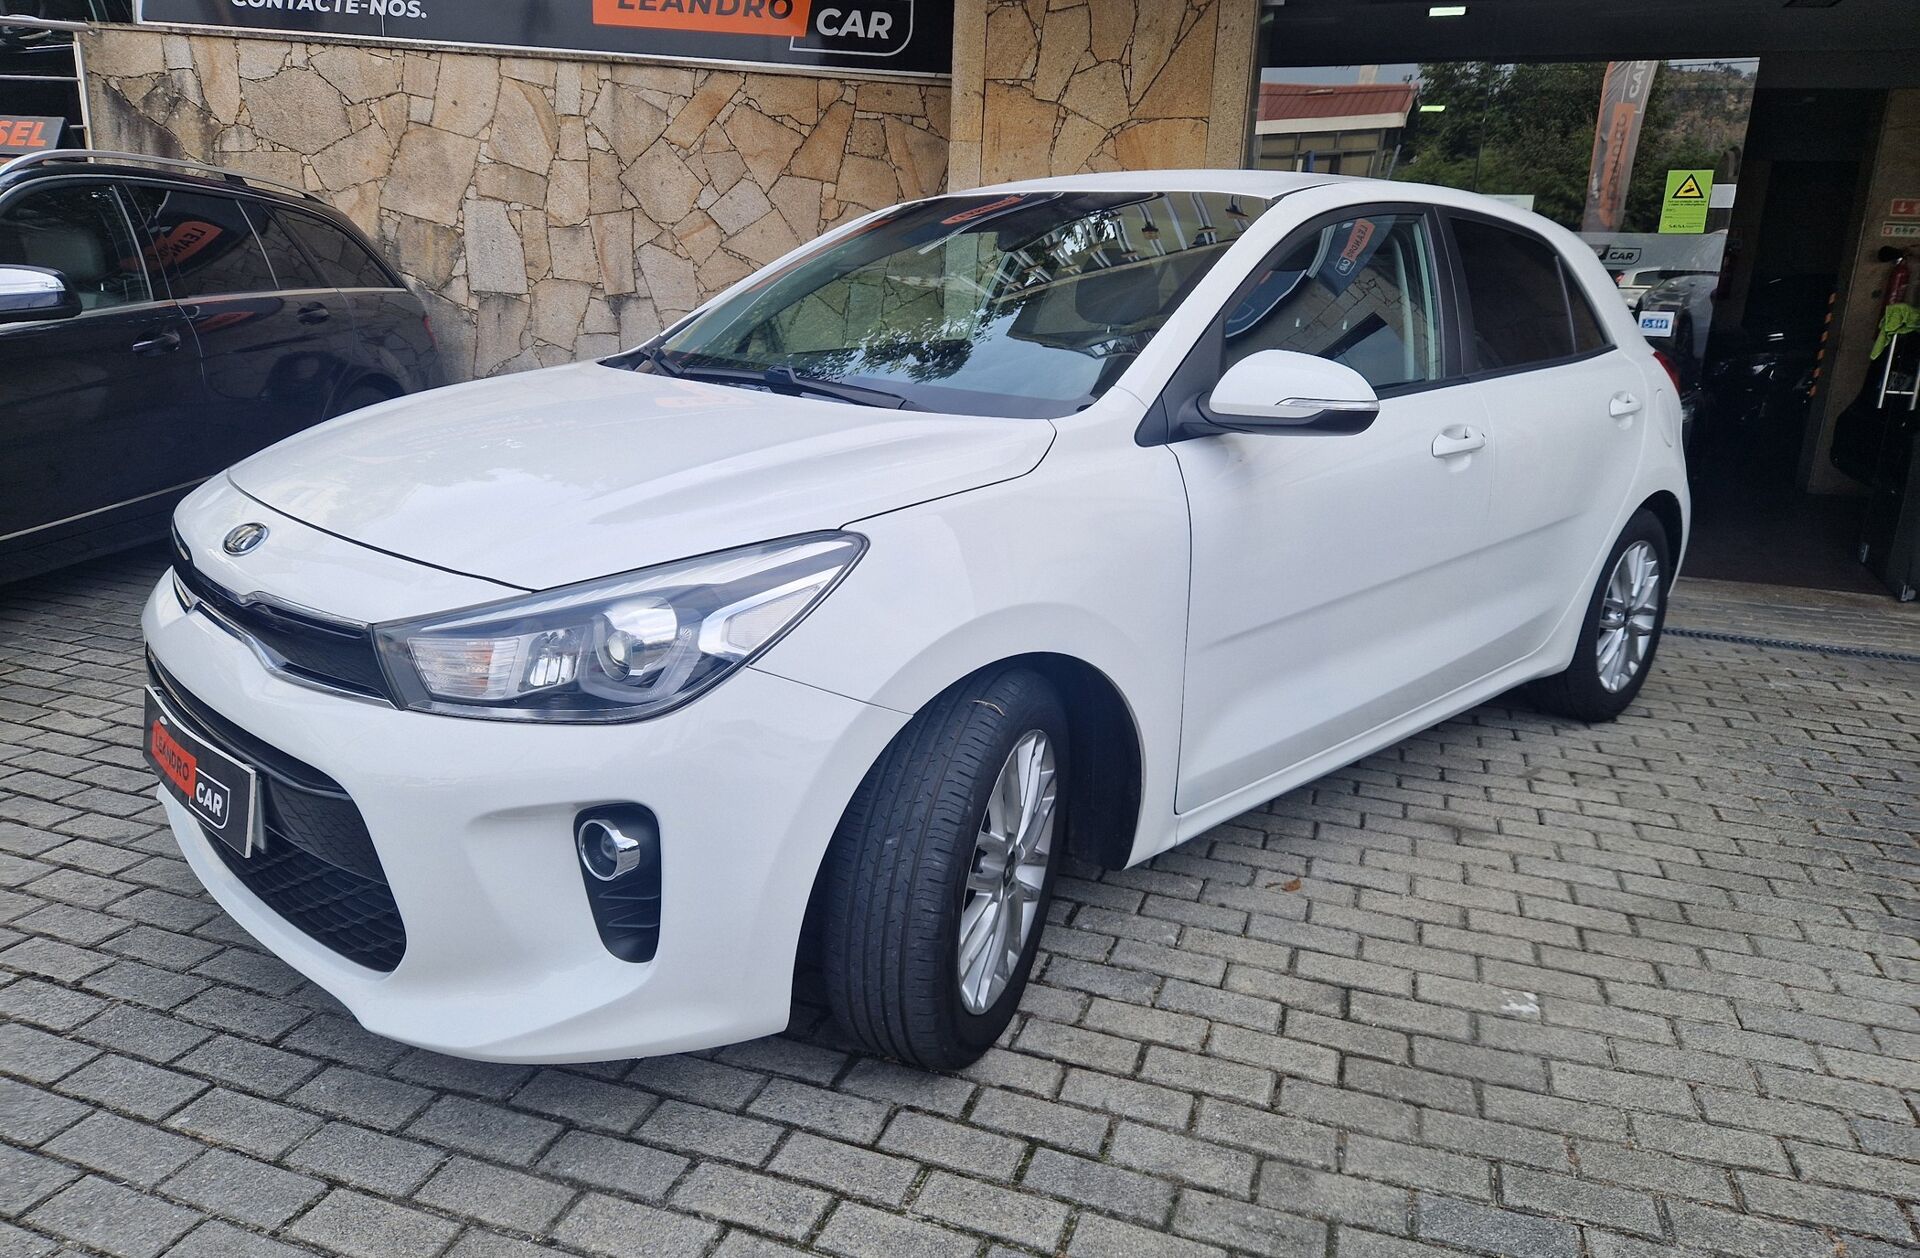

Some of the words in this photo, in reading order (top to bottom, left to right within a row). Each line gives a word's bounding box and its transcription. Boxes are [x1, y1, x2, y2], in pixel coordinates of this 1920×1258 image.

[816, 8, 893, 39] CAR
[1609, 251, 1634, 260] CAR
[155, 731, 190, 782] LEANDRO
[196, 782, 223, 817] CAR
